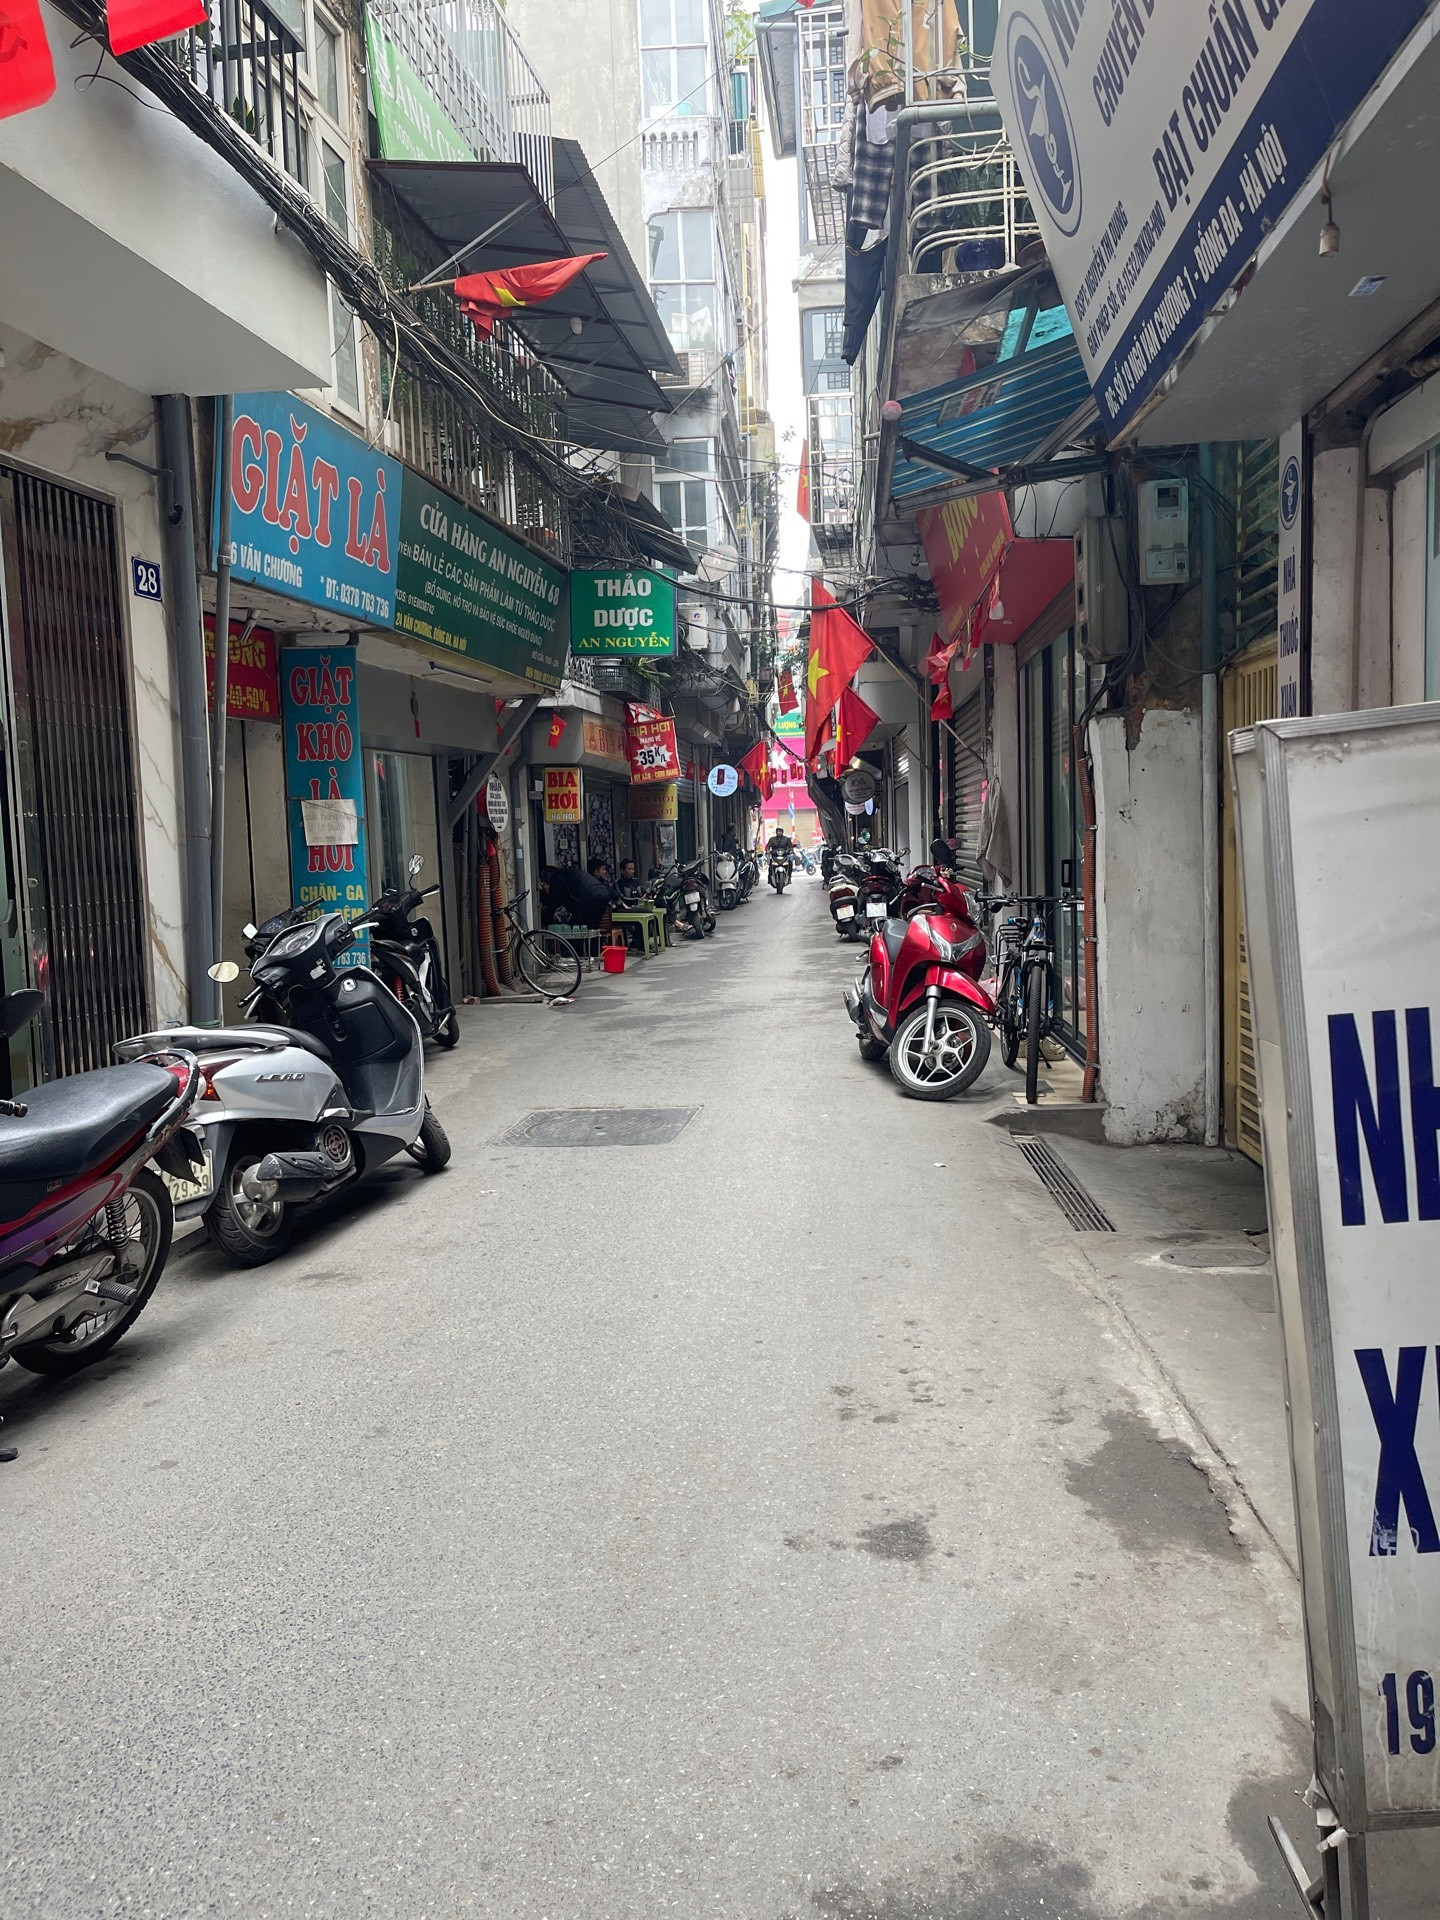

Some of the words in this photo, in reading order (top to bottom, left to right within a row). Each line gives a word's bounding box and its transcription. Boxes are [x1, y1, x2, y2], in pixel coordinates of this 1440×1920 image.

[1152, 109, 1194, 213] ĐẠT
[1182, 0, 1259, 153] CHUẨN
[1255, 123, 1288, 191] NỘI
[1239, 153, 1266, 215] HÀ
[1218, 195, 1243, 247] ĐA
[1193, 221, 1228, 284] ĐỐNG
[1183, 265, 1197, 300] 1
[1154, 275, 1191, 344] CHƯƠNG
[1127, 334, 1147, 384] NGÕ
[1139, 319, 1161, 365] VĂN
[1113, 360, 1128, 406] SỐ
[1121, 364, 1134, 394] 19
[231, 413, 339, 555] GIẶT
[345, 468, 390, 574] LÀ
[420, 502, 448, 542] CỬA
[451, 522, 488, 563] HÀNG
[488, 548, 506, 575] AN
[507, 557, 548, 599] NGUYỄN
[547, 586, 560, 606] 68
[1283, 546, 1296, 595] NHÀ
[137, 566, 158, 594] 28
[240, 543, 261, 574] VĂN
[264, 553, 303, 588] CHƯƠNG
[326, 577, 339, 601] ĐT:
[340, 583, 360, 608] 0378
[361, 590, 375, 613] 763
[376, 595, 390, 619] 736
[412, 543, 431, 569] BÁN
[432, 551, 444, 575] LẺ
[445, 560, 462, 585] CÁC
[463, 569, 479, 594] SẢN
[479, 579, 500, 603] PHẨM
[500, 590, 514, 611] LÀM
[514, 599, 524, 616] TỪ
[524, 602, 540, 626] THẢO
[540, 613, 556, 633] DƯỢC
[594, 573, 652, 597] THẢO
[403, 612, 413, 632] VĂN
[453, 591, 461, 609] HỖ
[461, 597, 472, 616] TRỢ
[472, 602, 479, 617] VÀ
[594, 607, 654, 631] DƯỢC
[579, 637, 600, 648] AN
[605, 632, 670, 648] NGUYỄN
[1280, 604, 1298, 659] THUỐC
[289, 654, 353, 714] GIẶT
[1281, 675, 1297, 719] XUÂN
[296, 710, 353, 761] KHÔ
[547, 771, 577, 788] BIA
[547, 790, 578, 809] HƠI
[346, 884, 364, 901] GA
[337, 952, 350, 966] 763
[352, 951, 366, 966] 736
[254, 1072, 305, 1082] LEAD
[1378, 1669, 1436, 1757] 19
